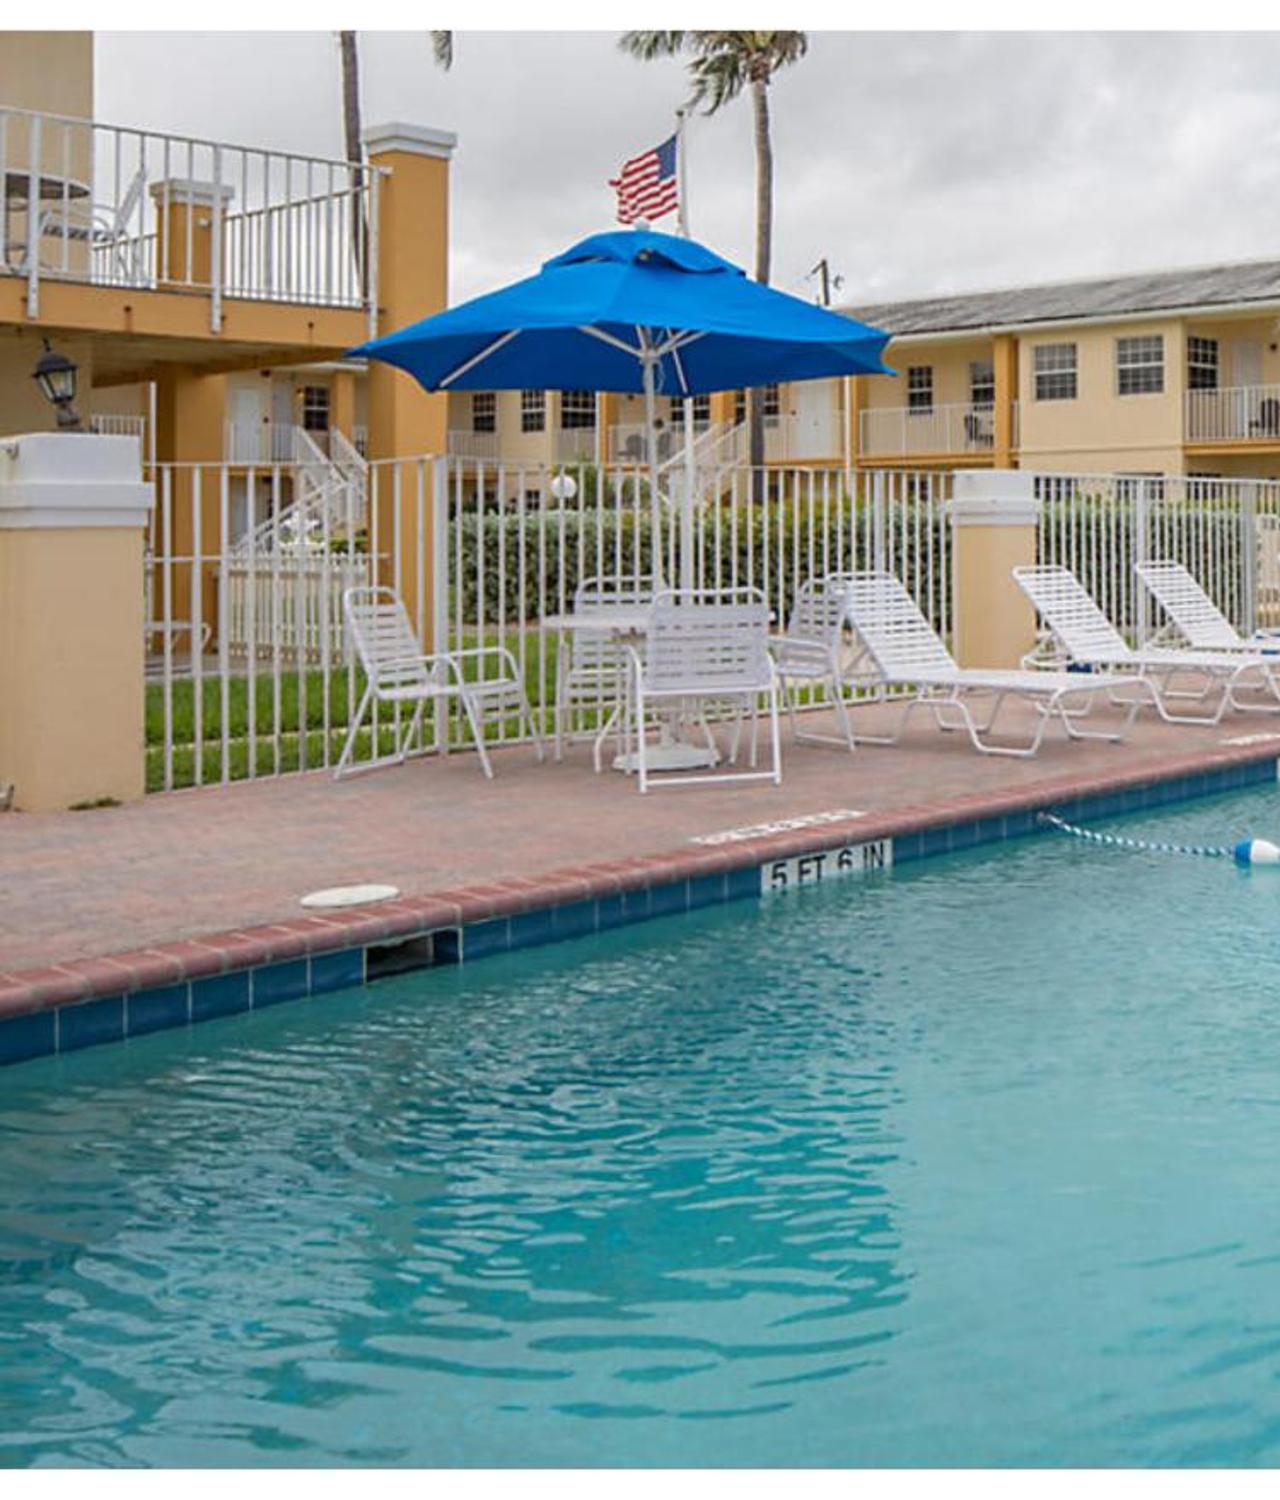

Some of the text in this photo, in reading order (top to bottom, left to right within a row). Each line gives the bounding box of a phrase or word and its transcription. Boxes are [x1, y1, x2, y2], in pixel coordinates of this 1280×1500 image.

[771, 842, 884, 889] 5 FT 6 IN
